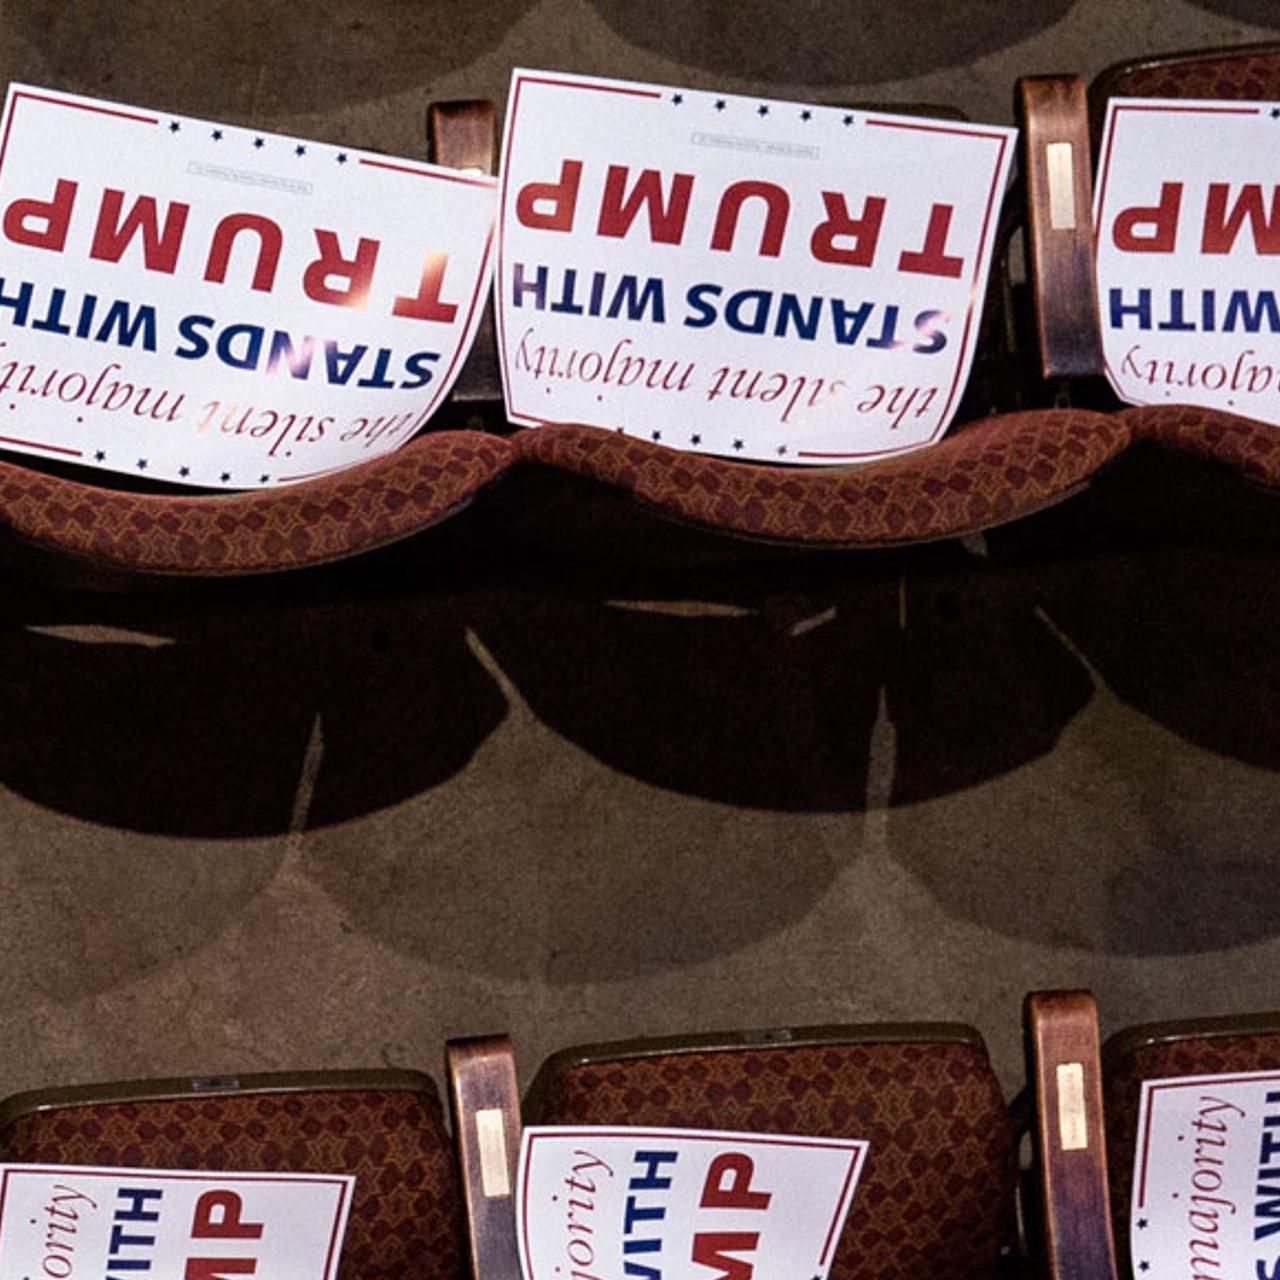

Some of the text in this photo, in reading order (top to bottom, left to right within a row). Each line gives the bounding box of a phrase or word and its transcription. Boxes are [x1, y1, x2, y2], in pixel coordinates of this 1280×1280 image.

[1, 178, 460, 324] TRUMP
[515, 158, 965, 279] TRUMP
[512, 262, 953, 356] STANDS WITH
[175, 314, 441, 390] STANDS
[515, 328, 694, 401] majority
[856, 383, 938, 429] the
